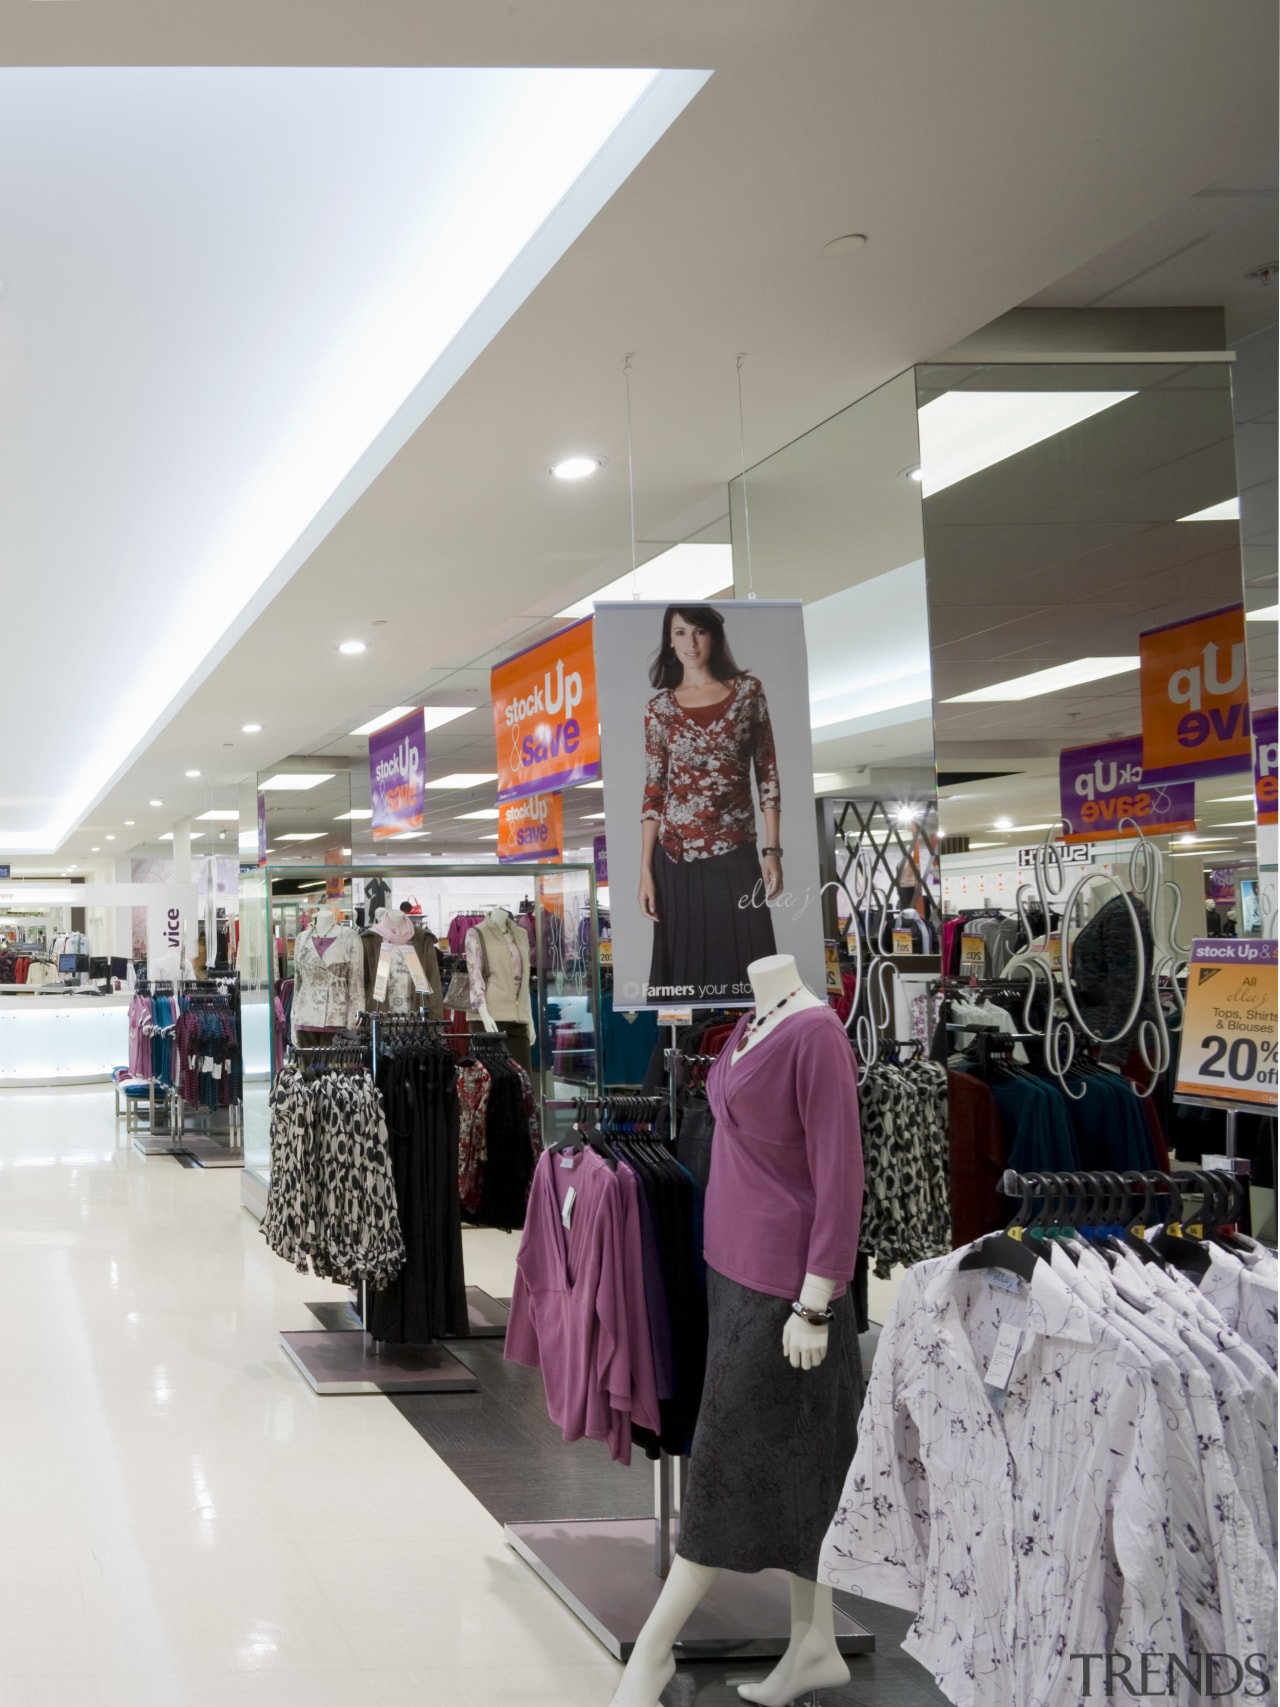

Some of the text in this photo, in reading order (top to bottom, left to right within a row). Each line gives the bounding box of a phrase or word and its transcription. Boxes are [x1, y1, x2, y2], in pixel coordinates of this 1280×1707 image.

[522, 718, 580, 767] save
[517, 823, 548, 846] save
[163, 908, 180, 947] vice
[1196, 946, 1235, 957] stock
[1238, 944, 1258, 960] Up
[1259, 944, 1271, 959] &
[642, 982, 695, 997] Farmers
[698, 984, 728, 998] your
[1242, 977, 1257, 987] All
[1213, 1007, 1242, 1020] Tops,
[1216, 1020, 1273, 1033] & Blouses
